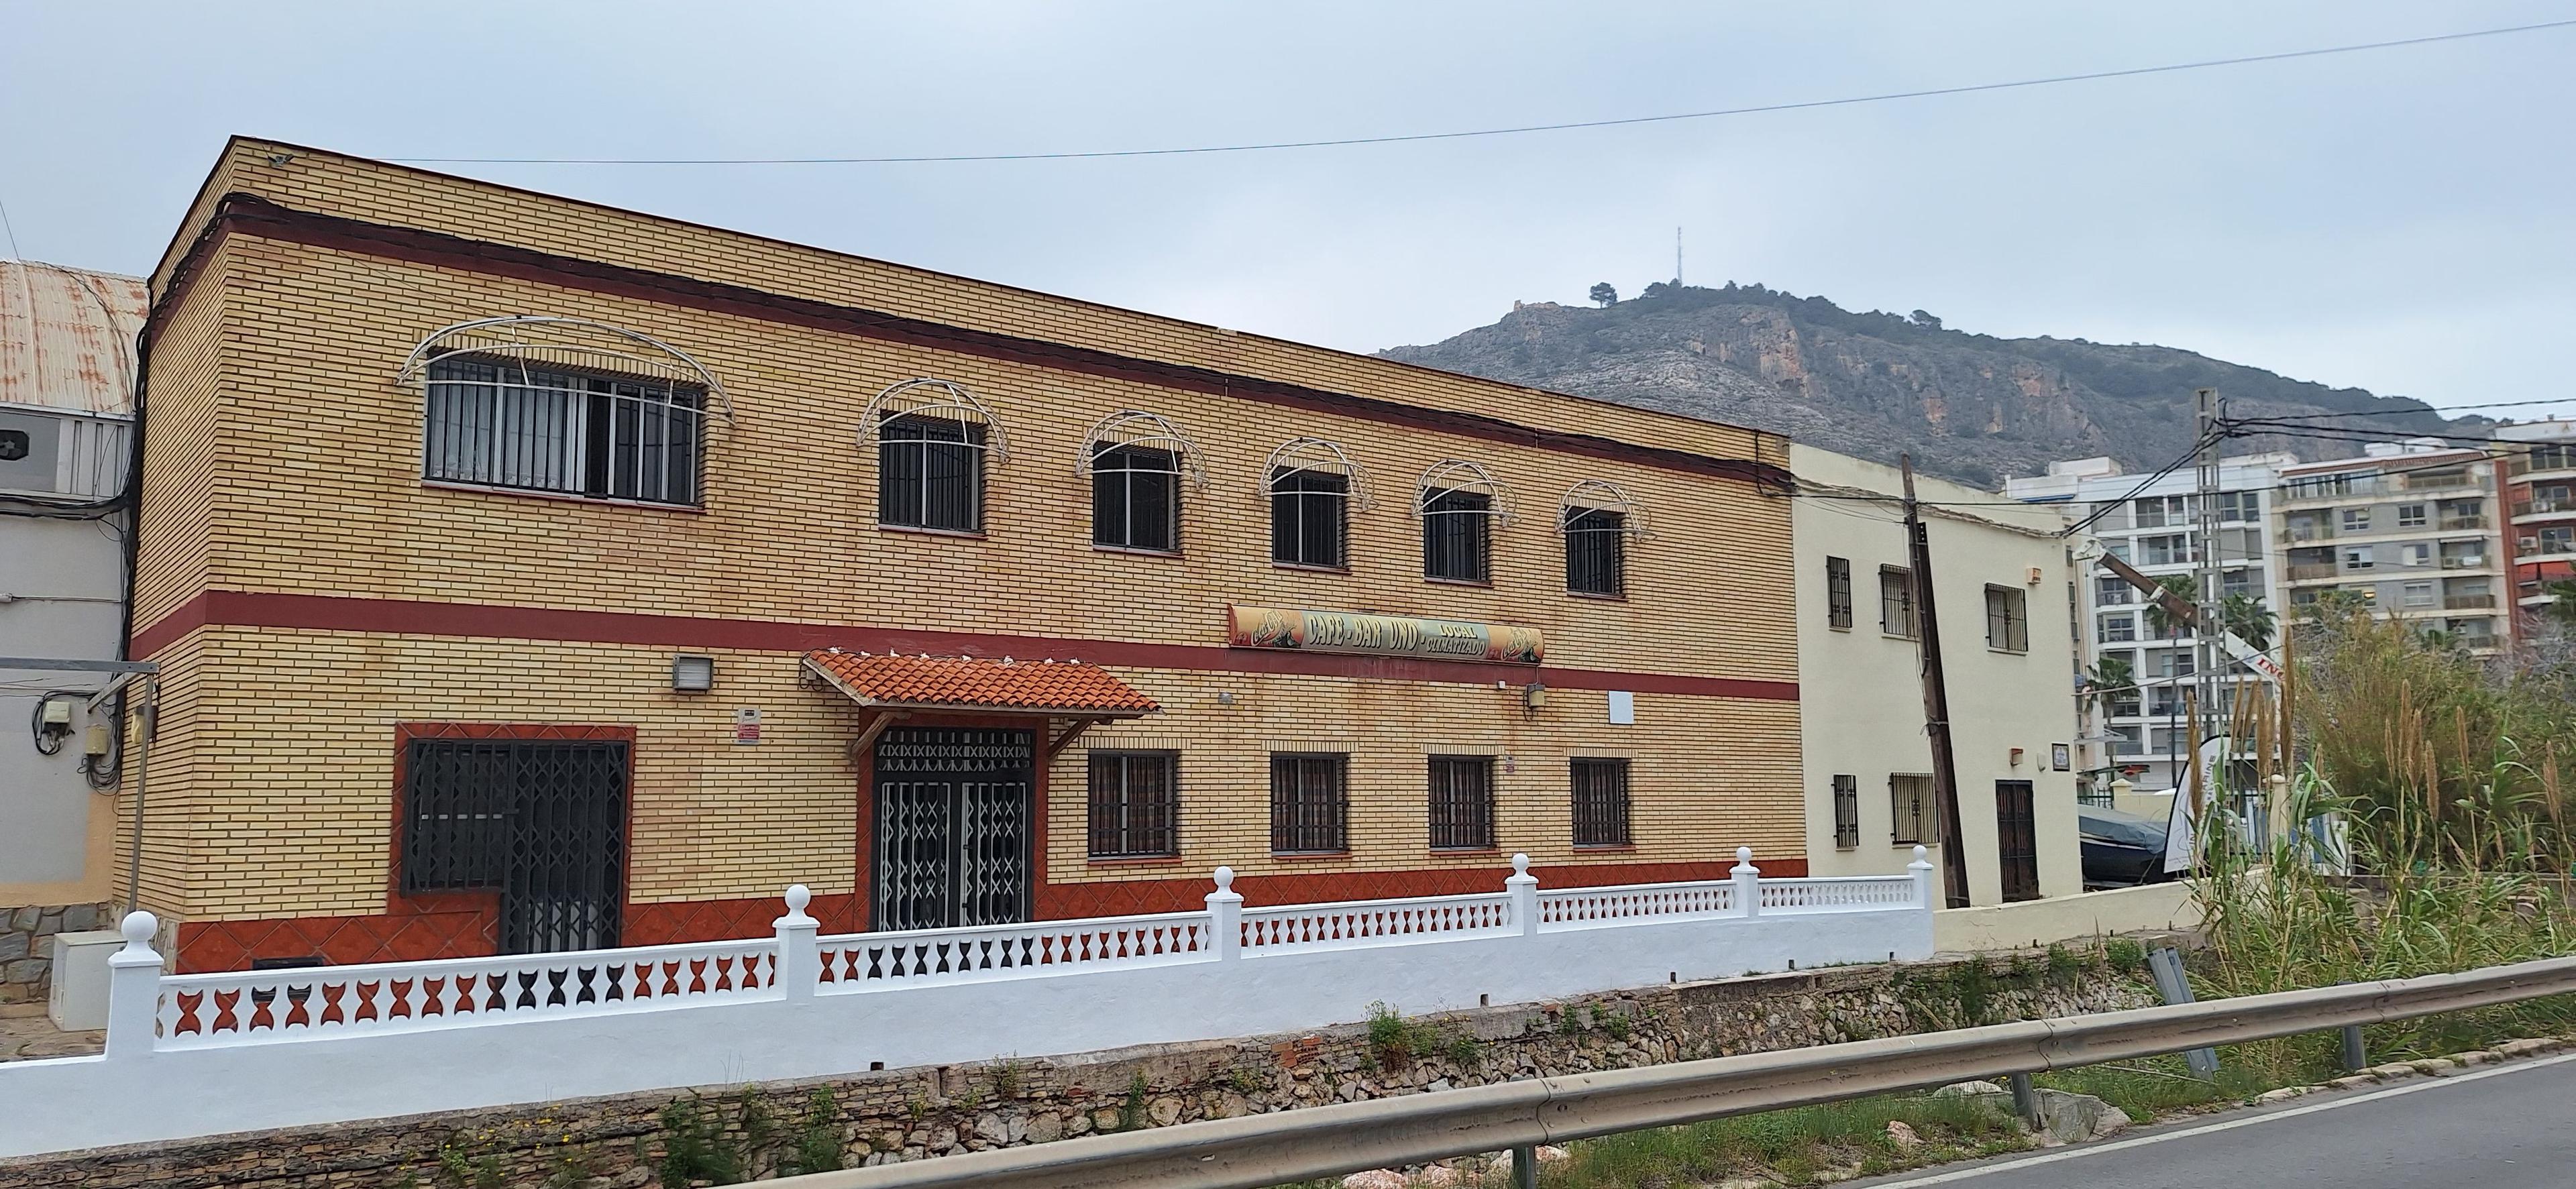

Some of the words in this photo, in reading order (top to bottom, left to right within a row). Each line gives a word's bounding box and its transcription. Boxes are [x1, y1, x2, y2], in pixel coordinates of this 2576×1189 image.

[1389, 621, 1419, 651] UNO
[1439, 624, 1478, 639] LOCAL
[1426, 637, 1486, 656] CLIMATIZADO
